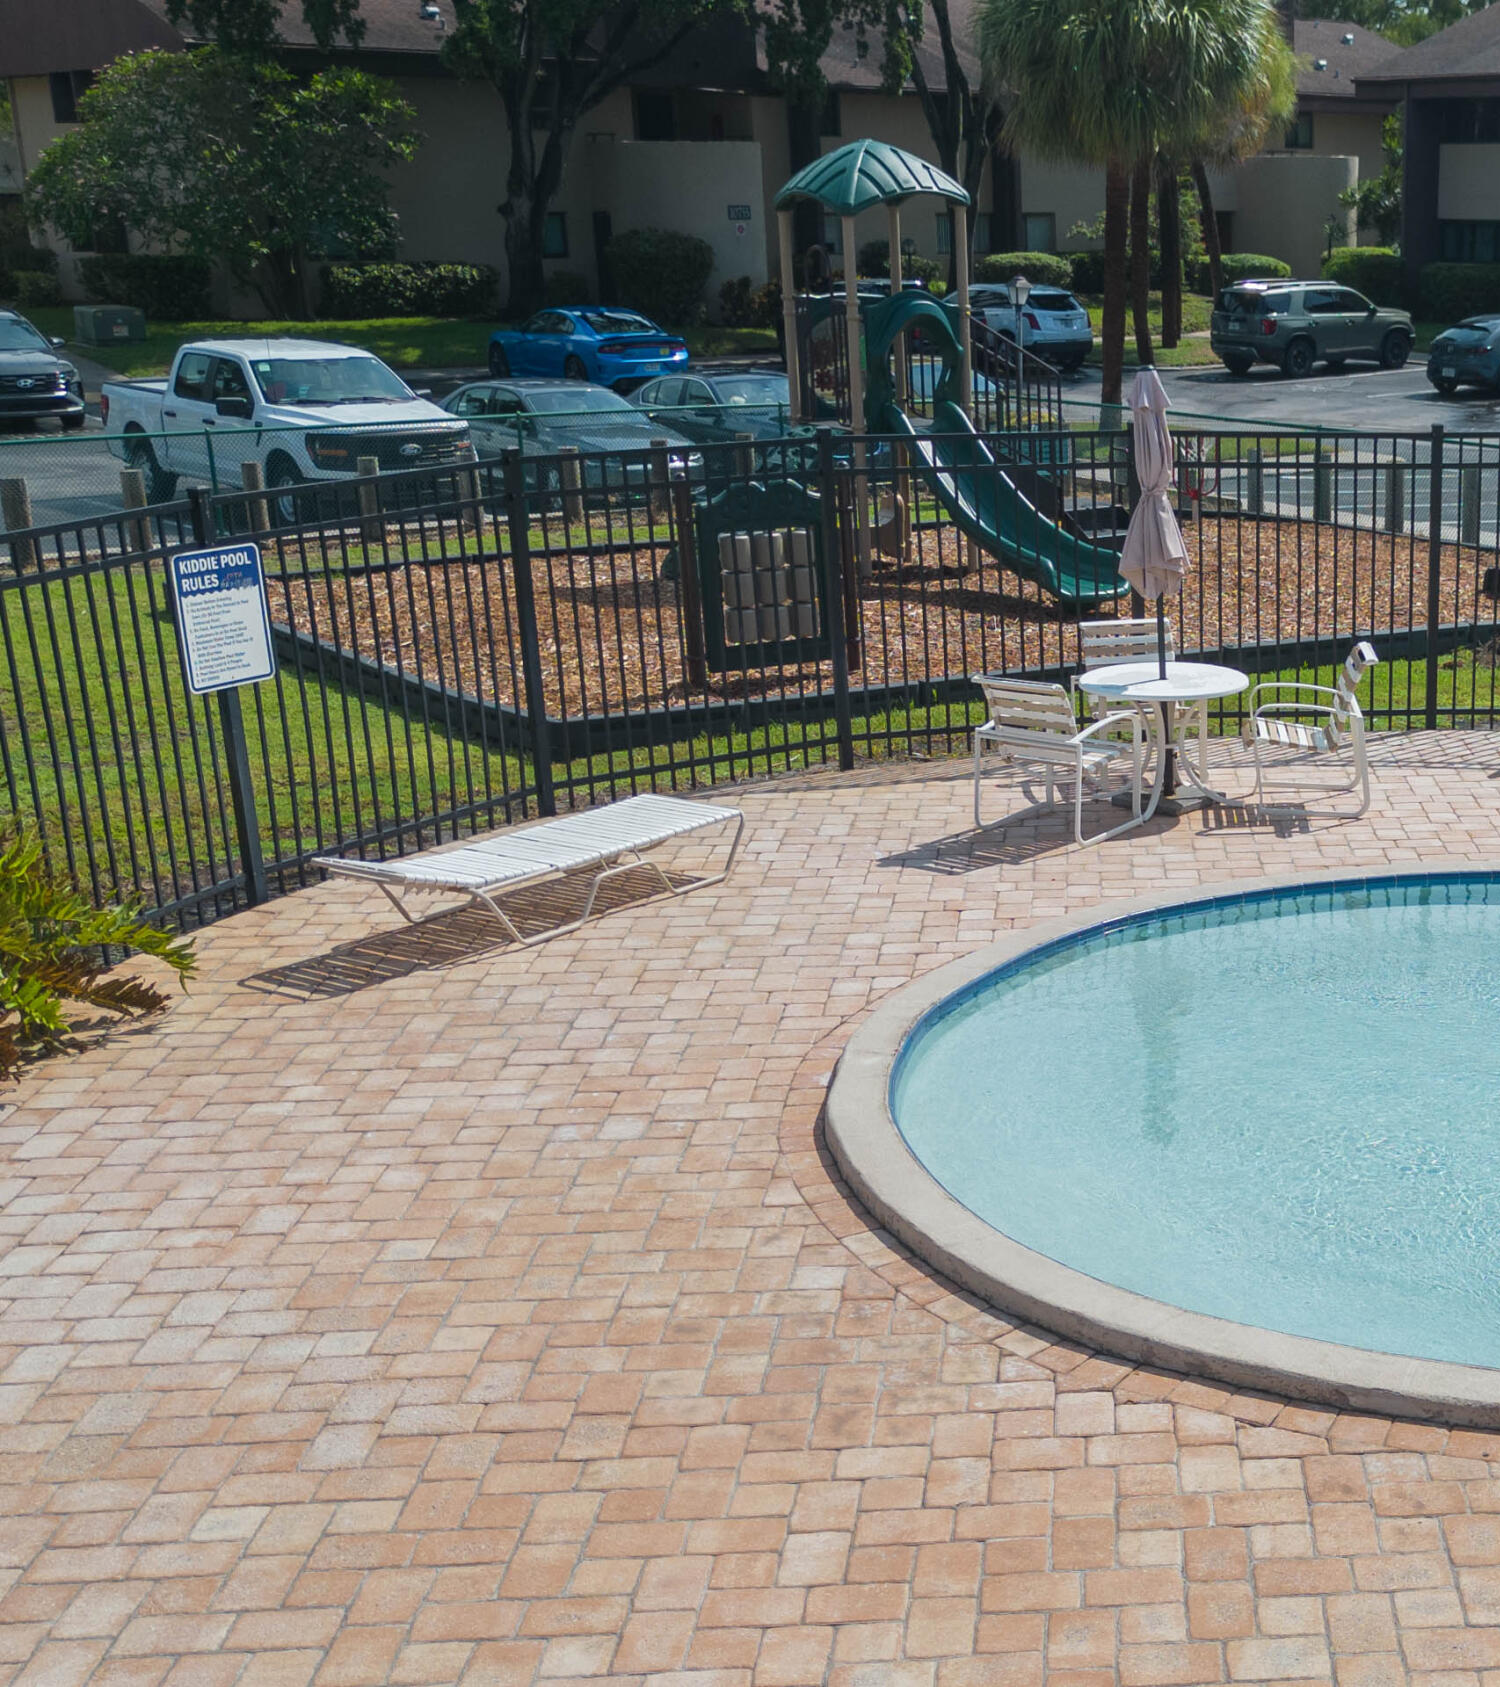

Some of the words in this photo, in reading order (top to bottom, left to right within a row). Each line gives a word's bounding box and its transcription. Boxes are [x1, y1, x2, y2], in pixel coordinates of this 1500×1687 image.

[179, 555, 219, 575] KIDDIE
[221, 551, 252, 569] POOL
[181, 574, 219, 592] RULES
